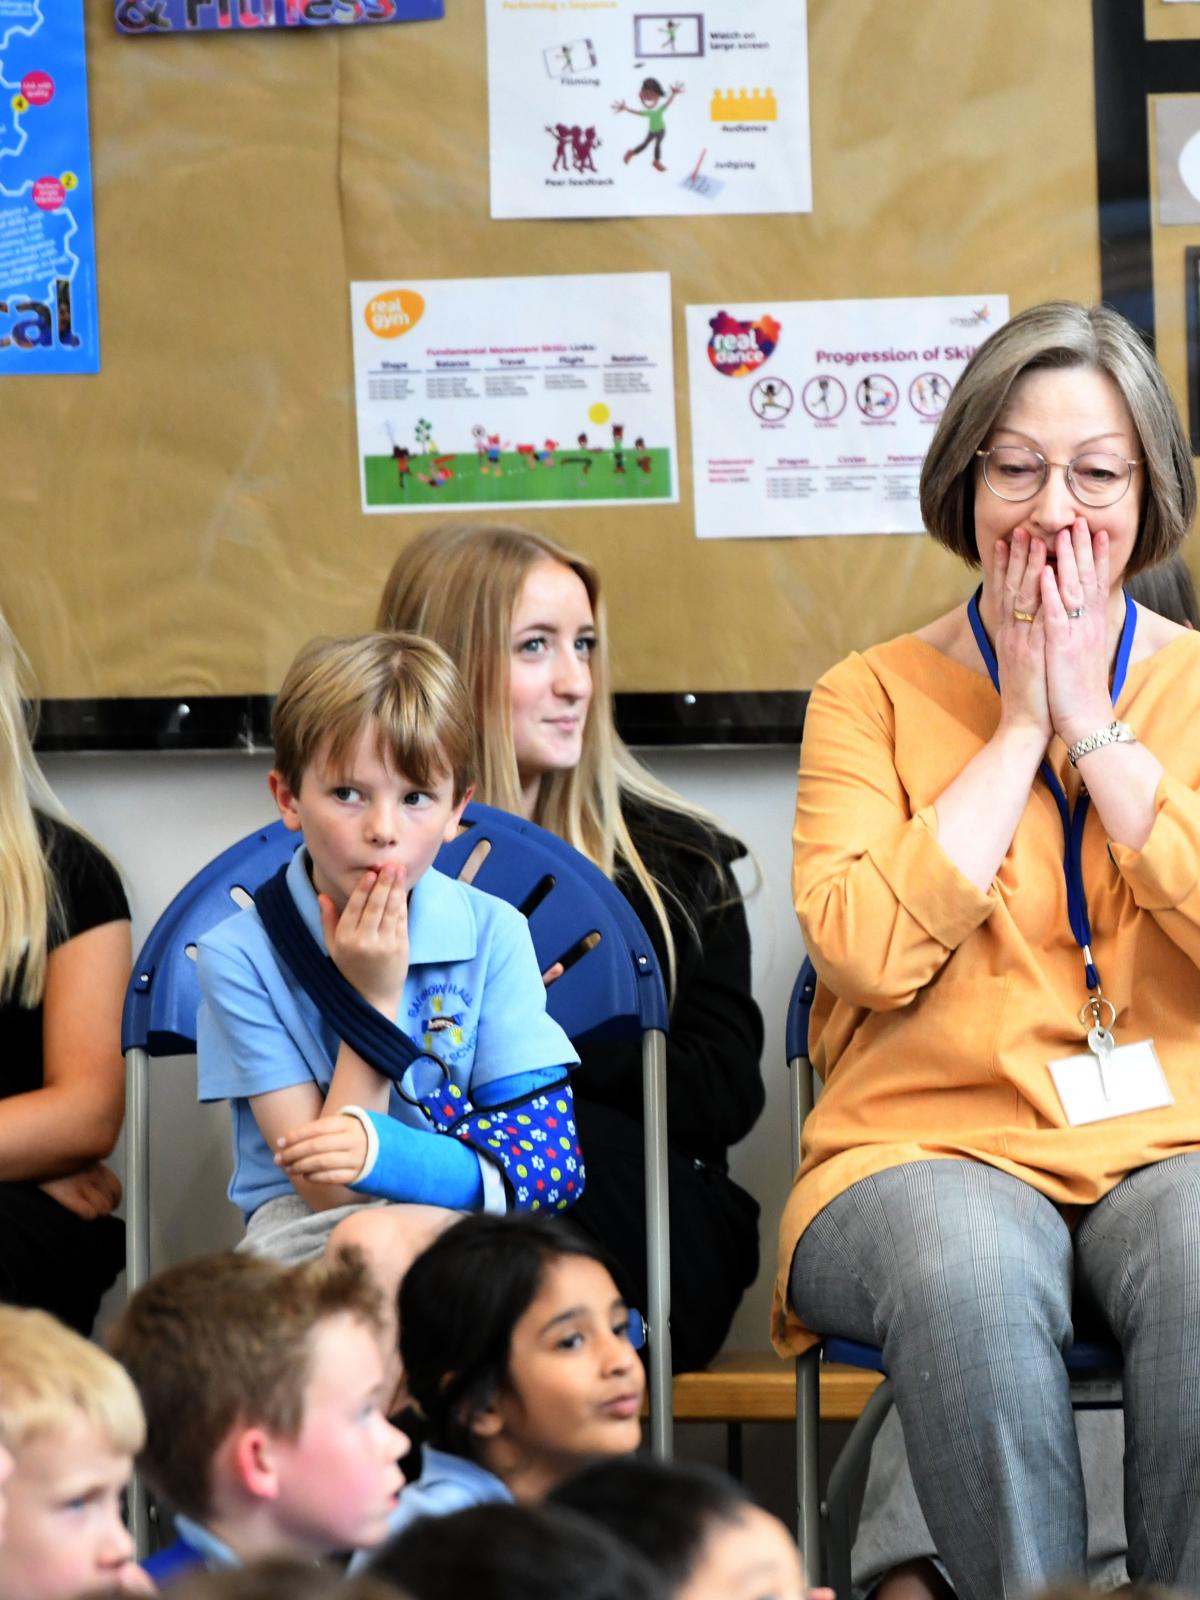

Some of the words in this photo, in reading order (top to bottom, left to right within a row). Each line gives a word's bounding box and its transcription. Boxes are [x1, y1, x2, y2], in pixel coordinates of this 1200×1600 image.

[710, 32, 741, 40] Watch
[738, 42, 770, 50] screen
[722, 124, 767, 132] Audience
[568, 177, 614, 186] feedback
[371, 297, 402, 313] real
[372, 312, 410, 331] gym
[714, 328, 760, 351] real
[716, 350, 765, 365] dance
[816, 347, 918, 367] Progression
[922, 347, 939, 362] of
